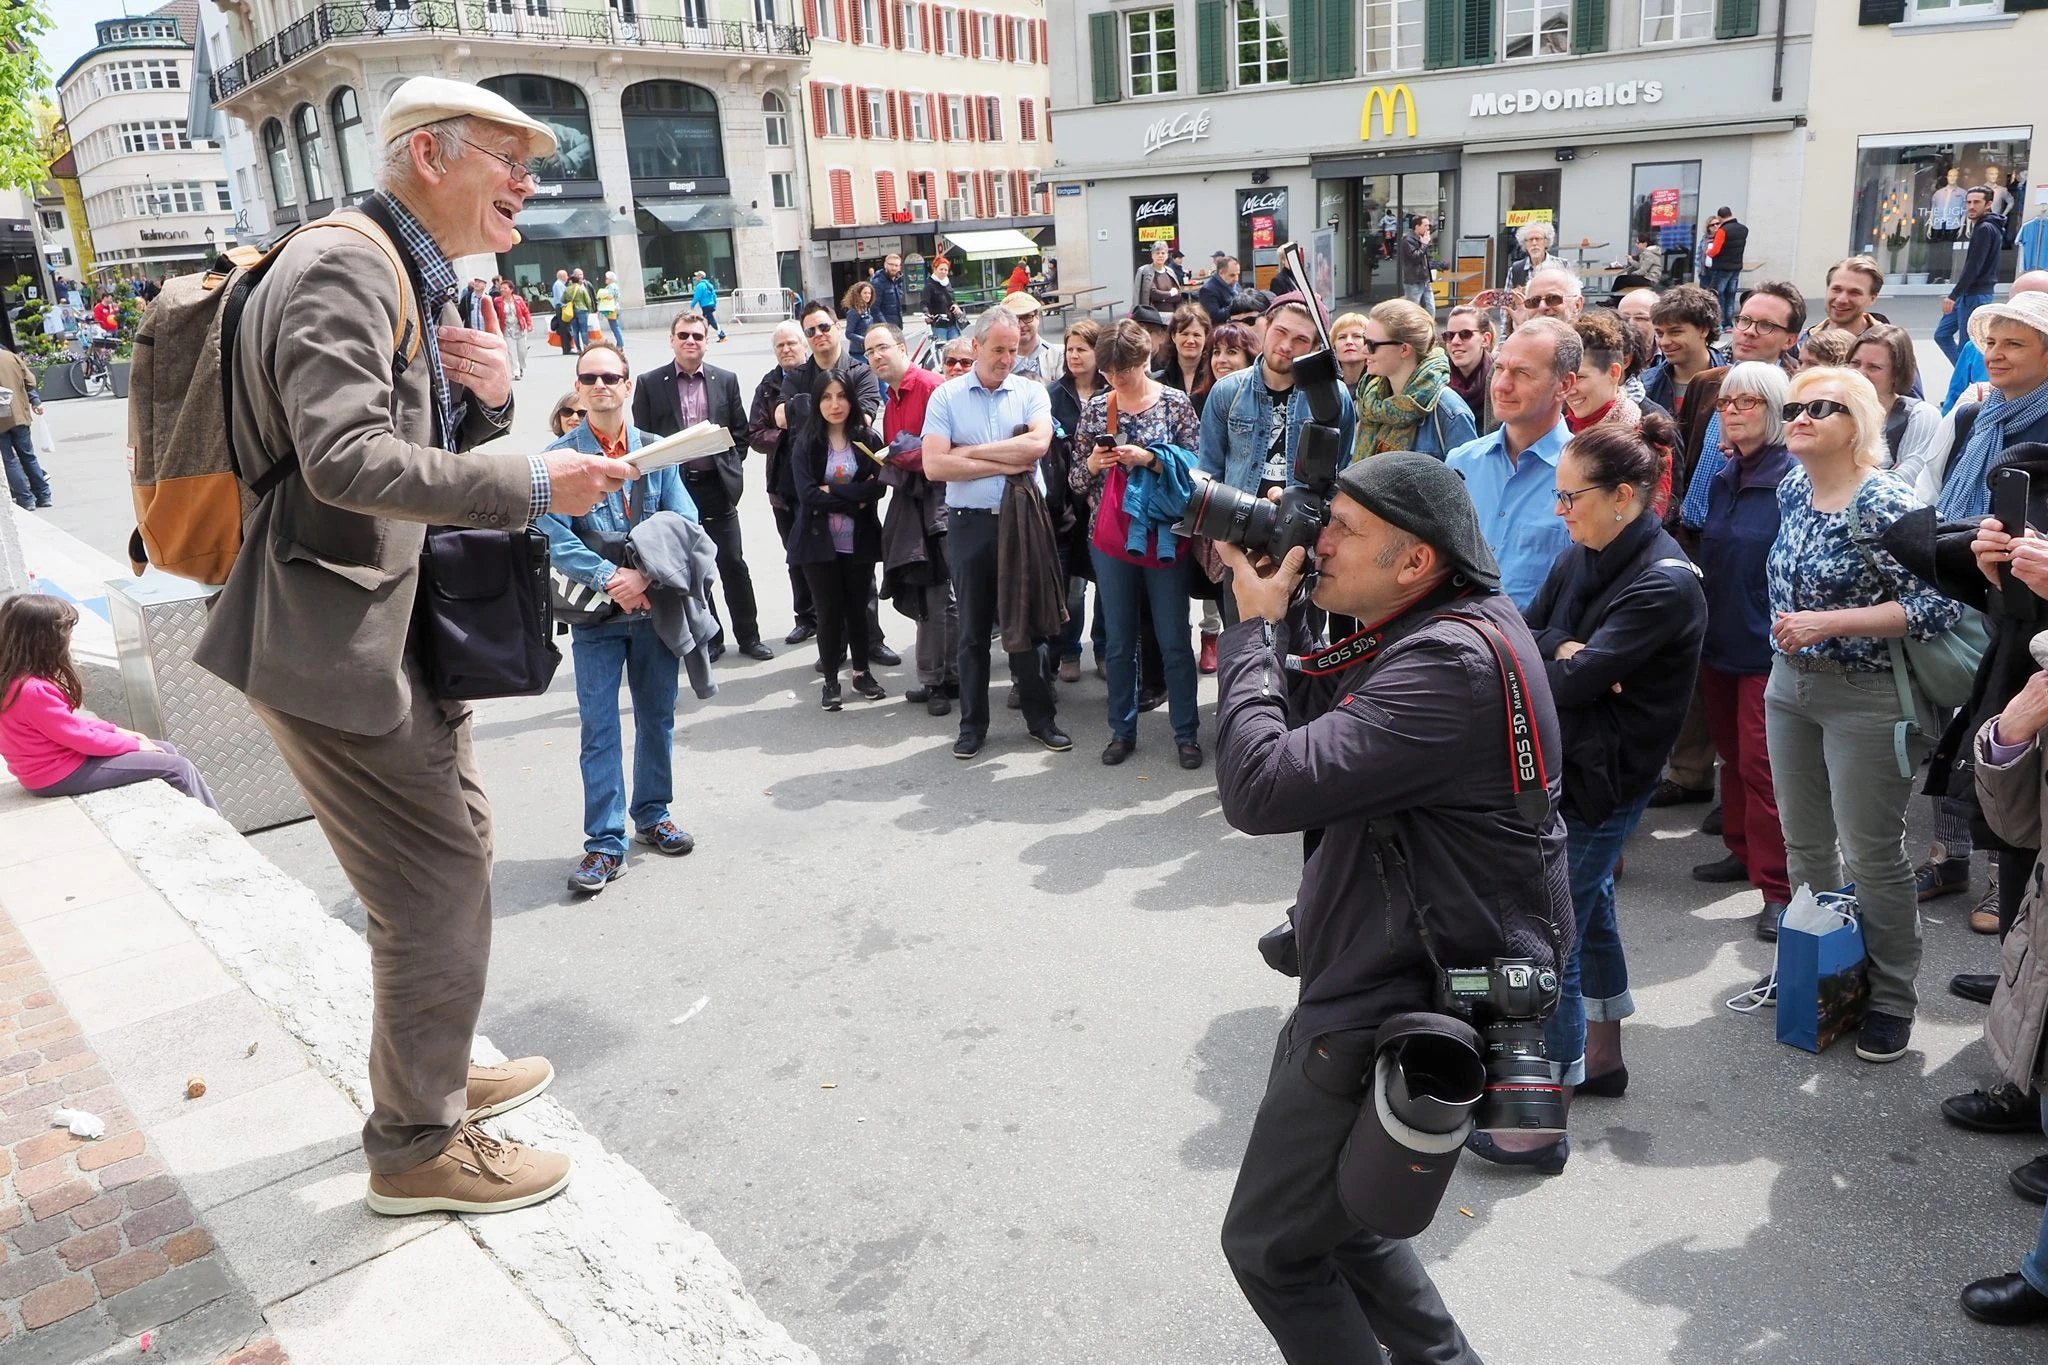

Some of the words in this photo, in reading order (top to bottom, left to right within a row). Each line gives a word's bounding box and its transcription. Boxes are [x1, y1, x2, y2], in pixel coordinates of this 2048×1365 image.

[1469, 80, 1663, 117] McDonald's
[1144, 108, 1211, 156] McCafé
[1136, 199, 1175, 221] McCafé
[1508, 212, 1531, 224] Neu!
[1918, 207, 1940, 217] THE
[1943, 206, 1967, 217] LIGH
[1925, 217, 1966, 227] APPEAL
[1141, 229, 1158, 239] Neu!
[1317, 646, 1352, 669] EOS
[1352, 635, 1377, 654] 5Ds
[1508, 671, 1516, 681] III
[1511, 682, 1523, 709] Mark
[1513, 713, 1528, 734] 5D
[1516, 739, 1535, 781] EOS
